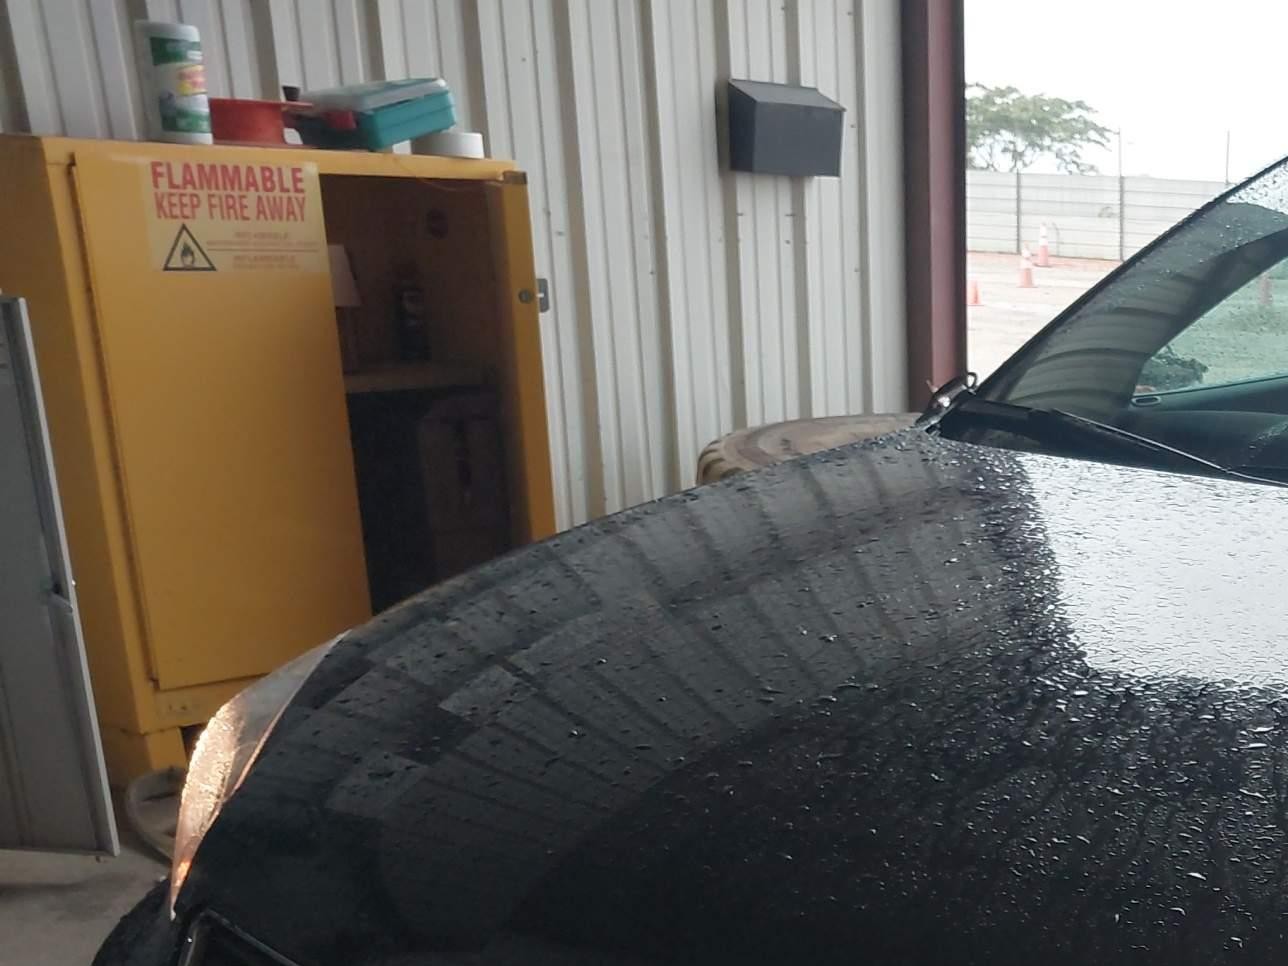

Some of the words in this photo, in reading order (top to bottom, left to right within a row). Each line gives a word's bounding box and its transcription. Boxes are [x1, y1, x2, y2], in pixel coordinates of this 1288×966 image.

[150, 161, 305, 193] FLAMMABLE
[154, 192, 201, 219] KEEP
[207, 194, 250, 221] FIRE
[256, 196, 306, 222] AWAY
